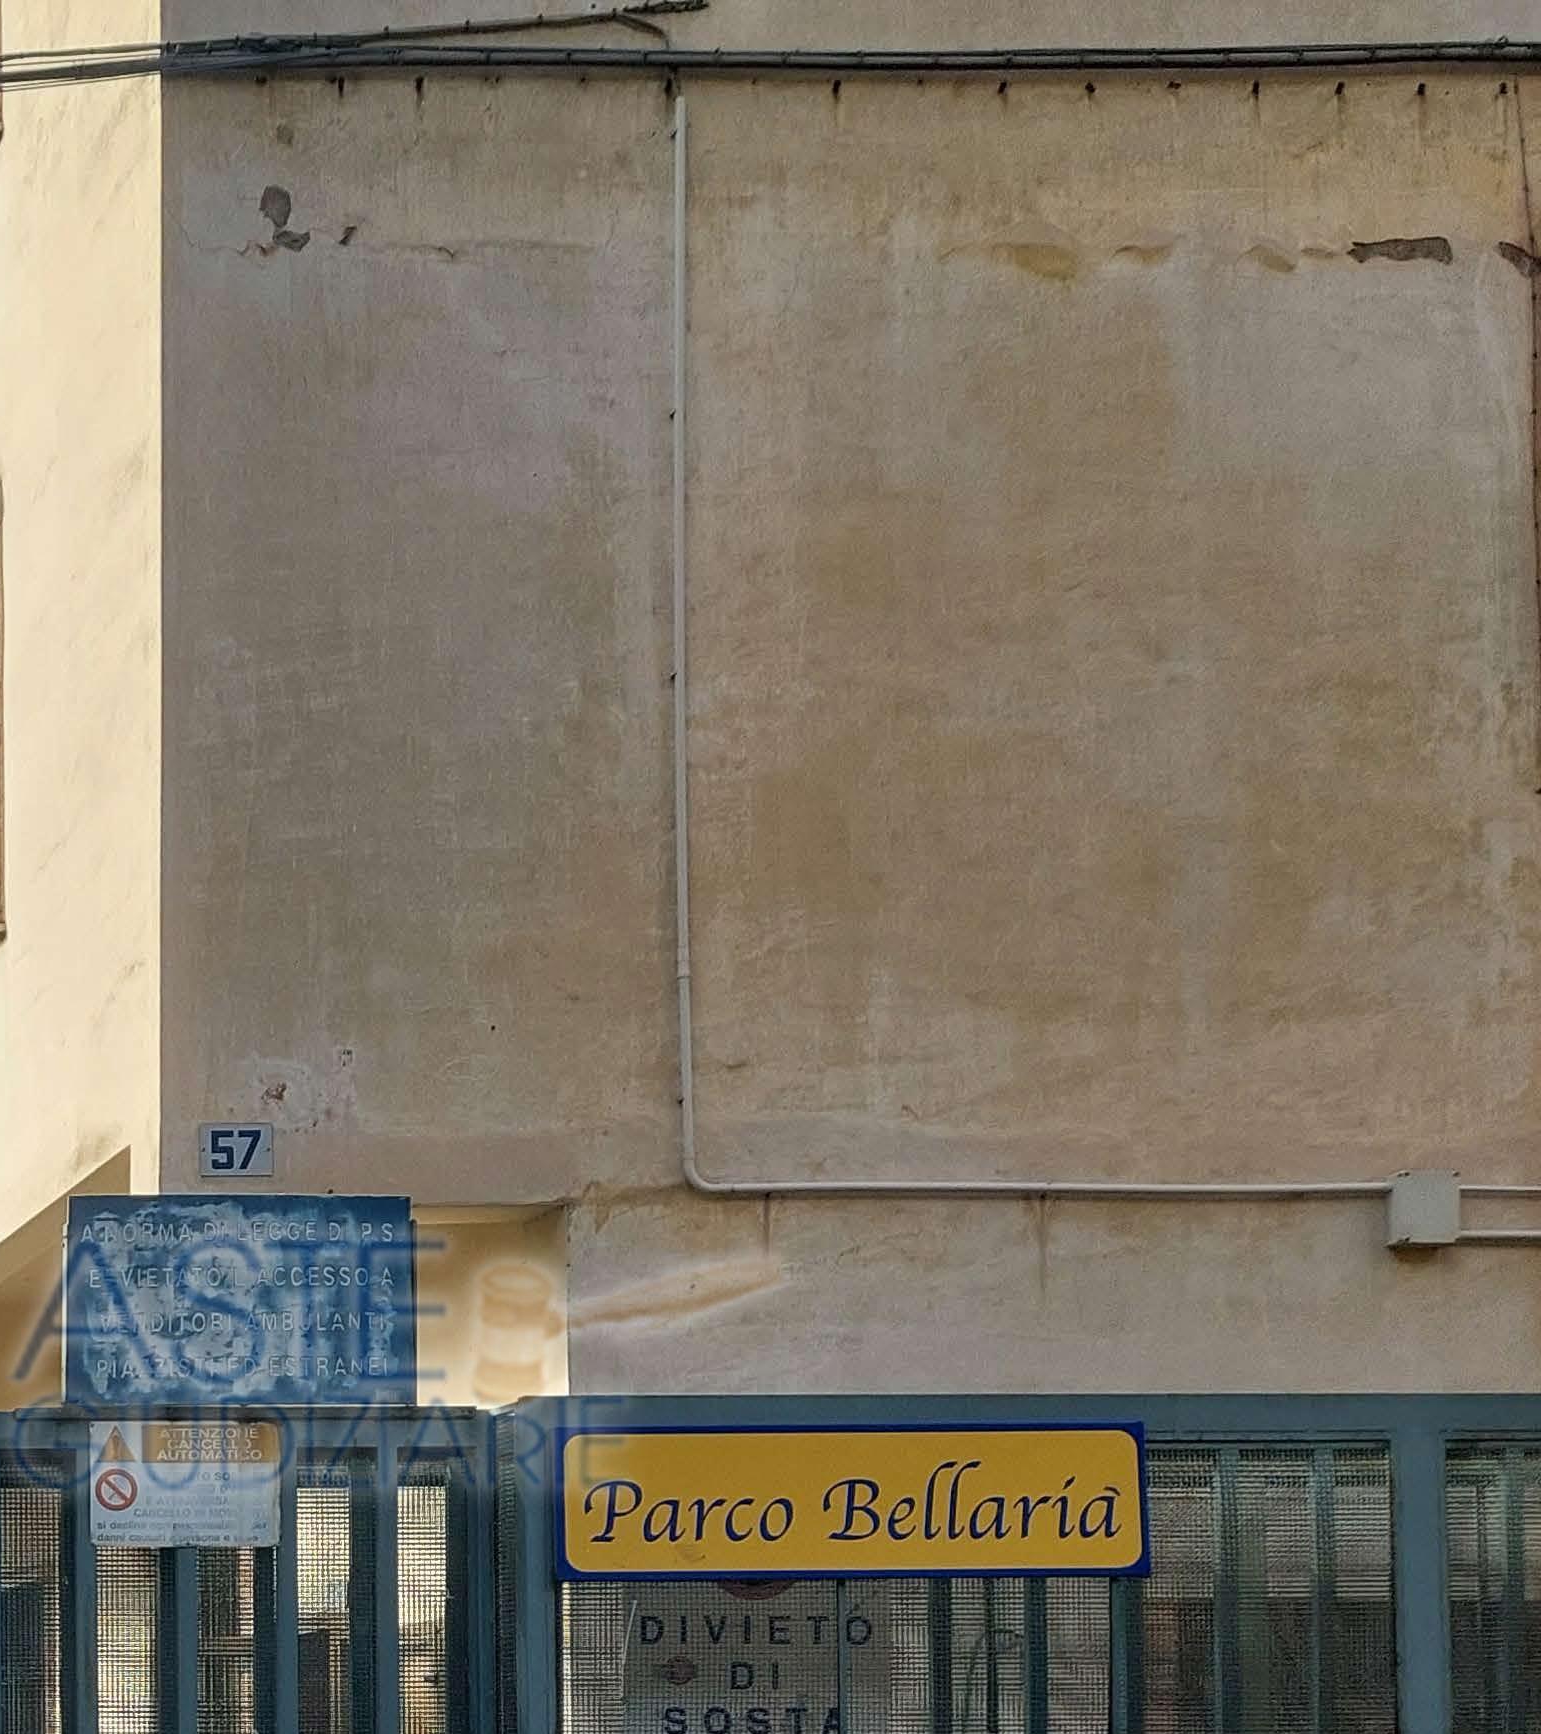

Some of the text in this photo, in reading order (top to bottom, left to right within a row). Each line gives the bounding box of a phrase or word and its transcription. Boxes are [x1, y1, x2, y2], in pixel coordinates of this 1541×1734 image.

[210, 1129, 262, 1170] 57
[80, 1223, 95, 1243] A
[237, 1222, 317, 1242] LEGGE
[120, 1267, 223, 1289] VIETATO
[380, 1266, 395, 1288] A
[245, 1311, 385, 1332] AMBULANTI
[97, 1358, 218, 1380] PIAZISTI
[268, 1357, 389, 1378] ESTRANEI
[584, 1460, 1123, 1543] Parco Bellarià
[639, 1615, 873, 1646] DIVIETO
[729, 1661, 781, 1690] DI
